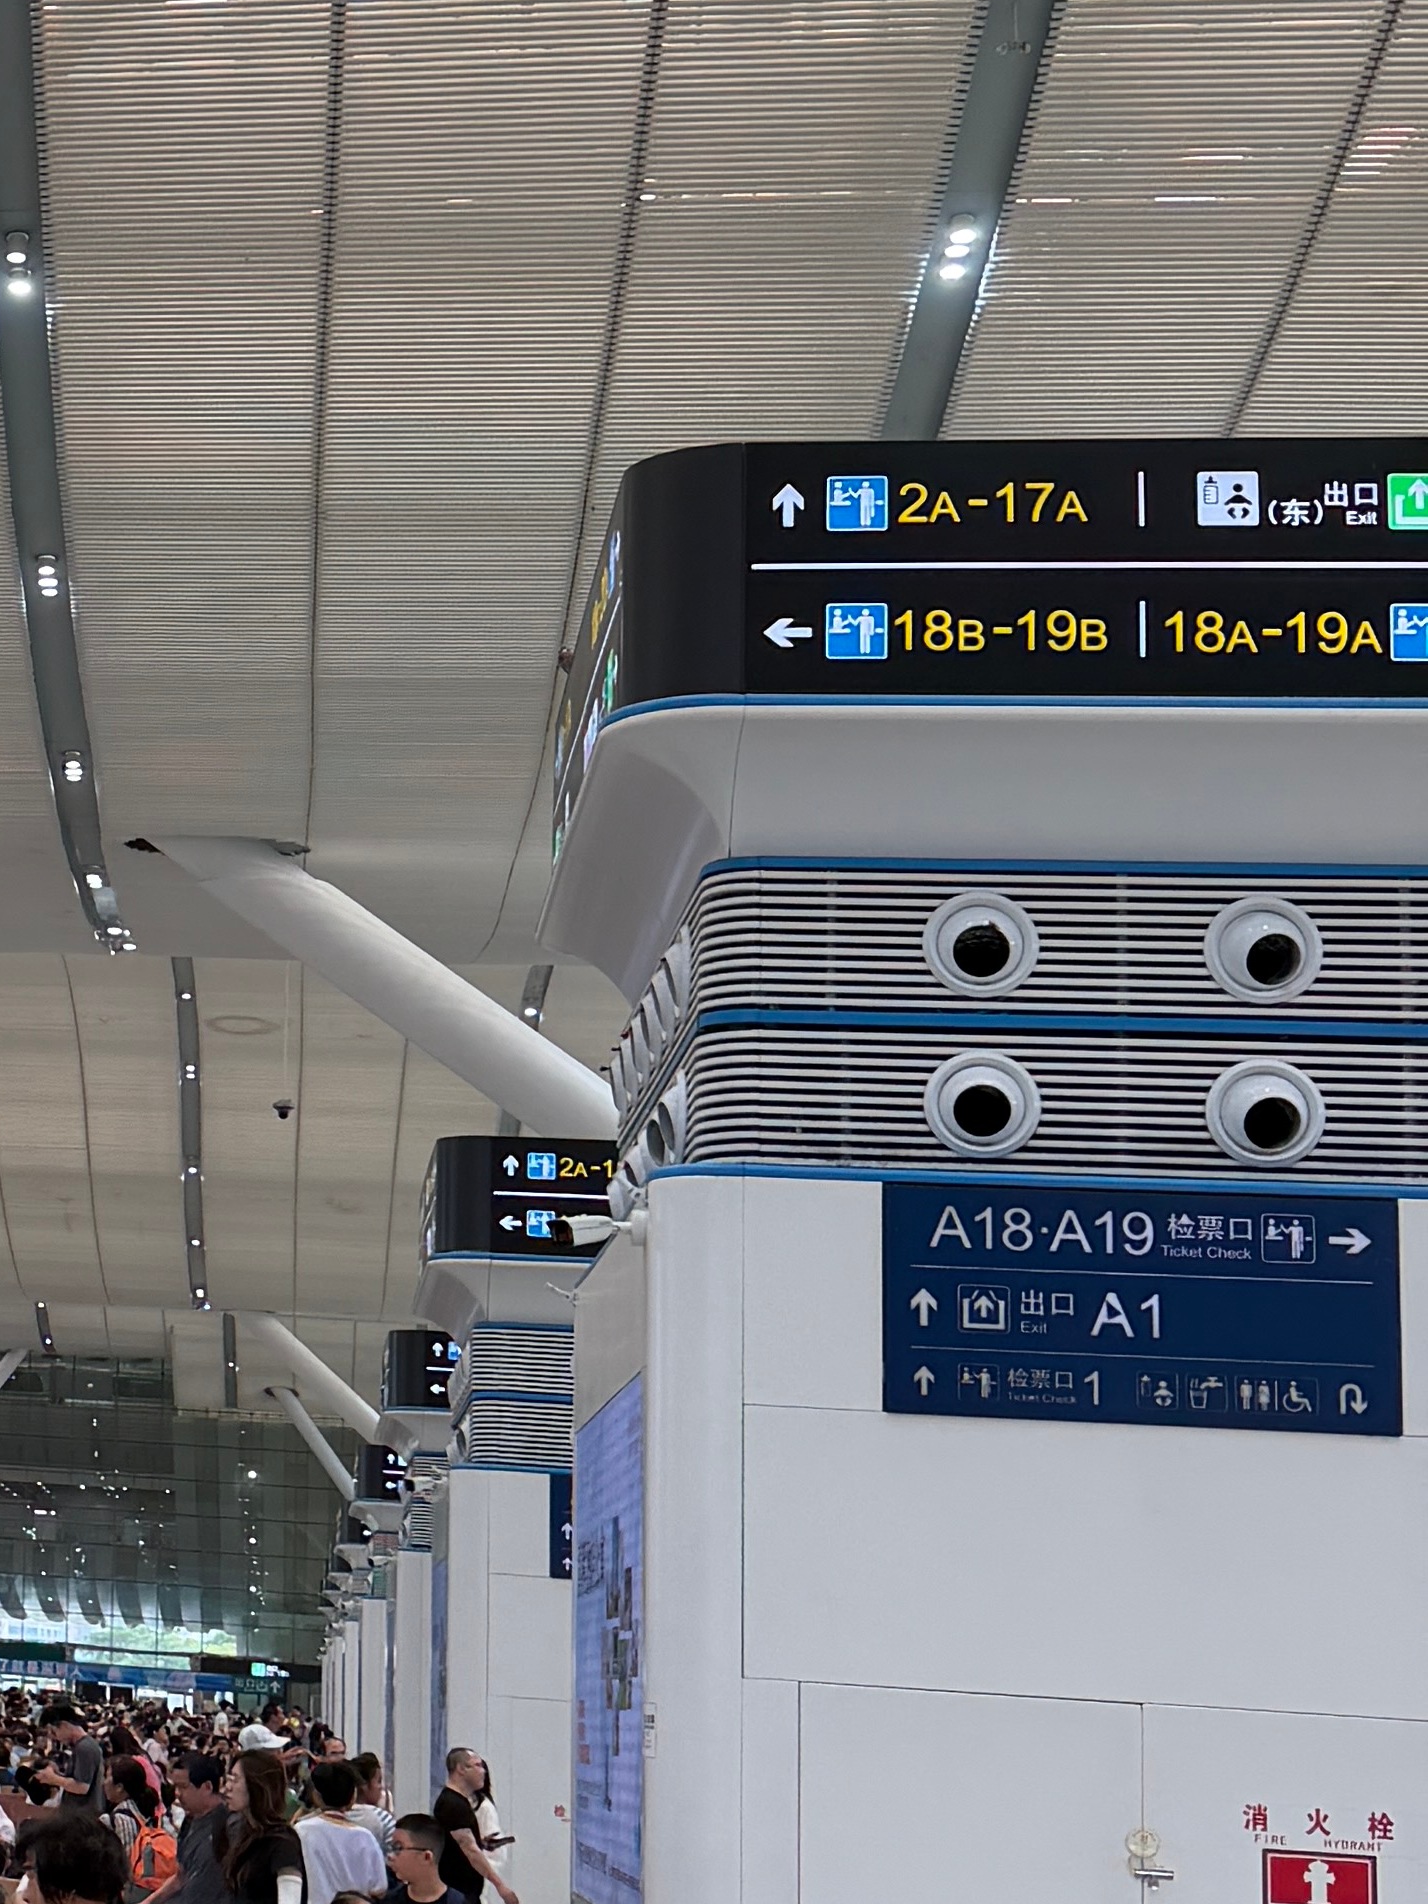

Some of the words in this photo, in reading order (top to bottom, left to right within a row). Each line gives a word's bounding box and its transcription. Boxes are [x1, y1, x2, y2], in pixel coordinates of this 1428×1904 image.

[898, 481, 1088, 525] 2A-17A
[1324, 482, 1379, 506] 出口
[1345, 509, 1378, 526] Exit
[893, 610, 1107, 653] 18B-19B
[1164, 611, 1382, 654] 18A-19A
[559, 1157, 613, 1178] 2A-1
[1168, 1213, 1253, 1241] 检票口
[1161, 1244, 1203, 1259] Ticket
[1206, 1246, 1252, 1260] Check
[1020, 1321, 1047, 1335] Exit
[1021, 1290, 1075, 1317] 出口
[1090, 1293, 1161, 1339] A1
[1007, 1368, 1074, 1390] 检票口
[1084, 1370, 1101, 1406] 1
[1244, 1804, 1394, 1841] 消火栓
[1254, 1834, 1288, 1847] FIRE
[1323, 1839, 1384, 1853] HYDRANT
